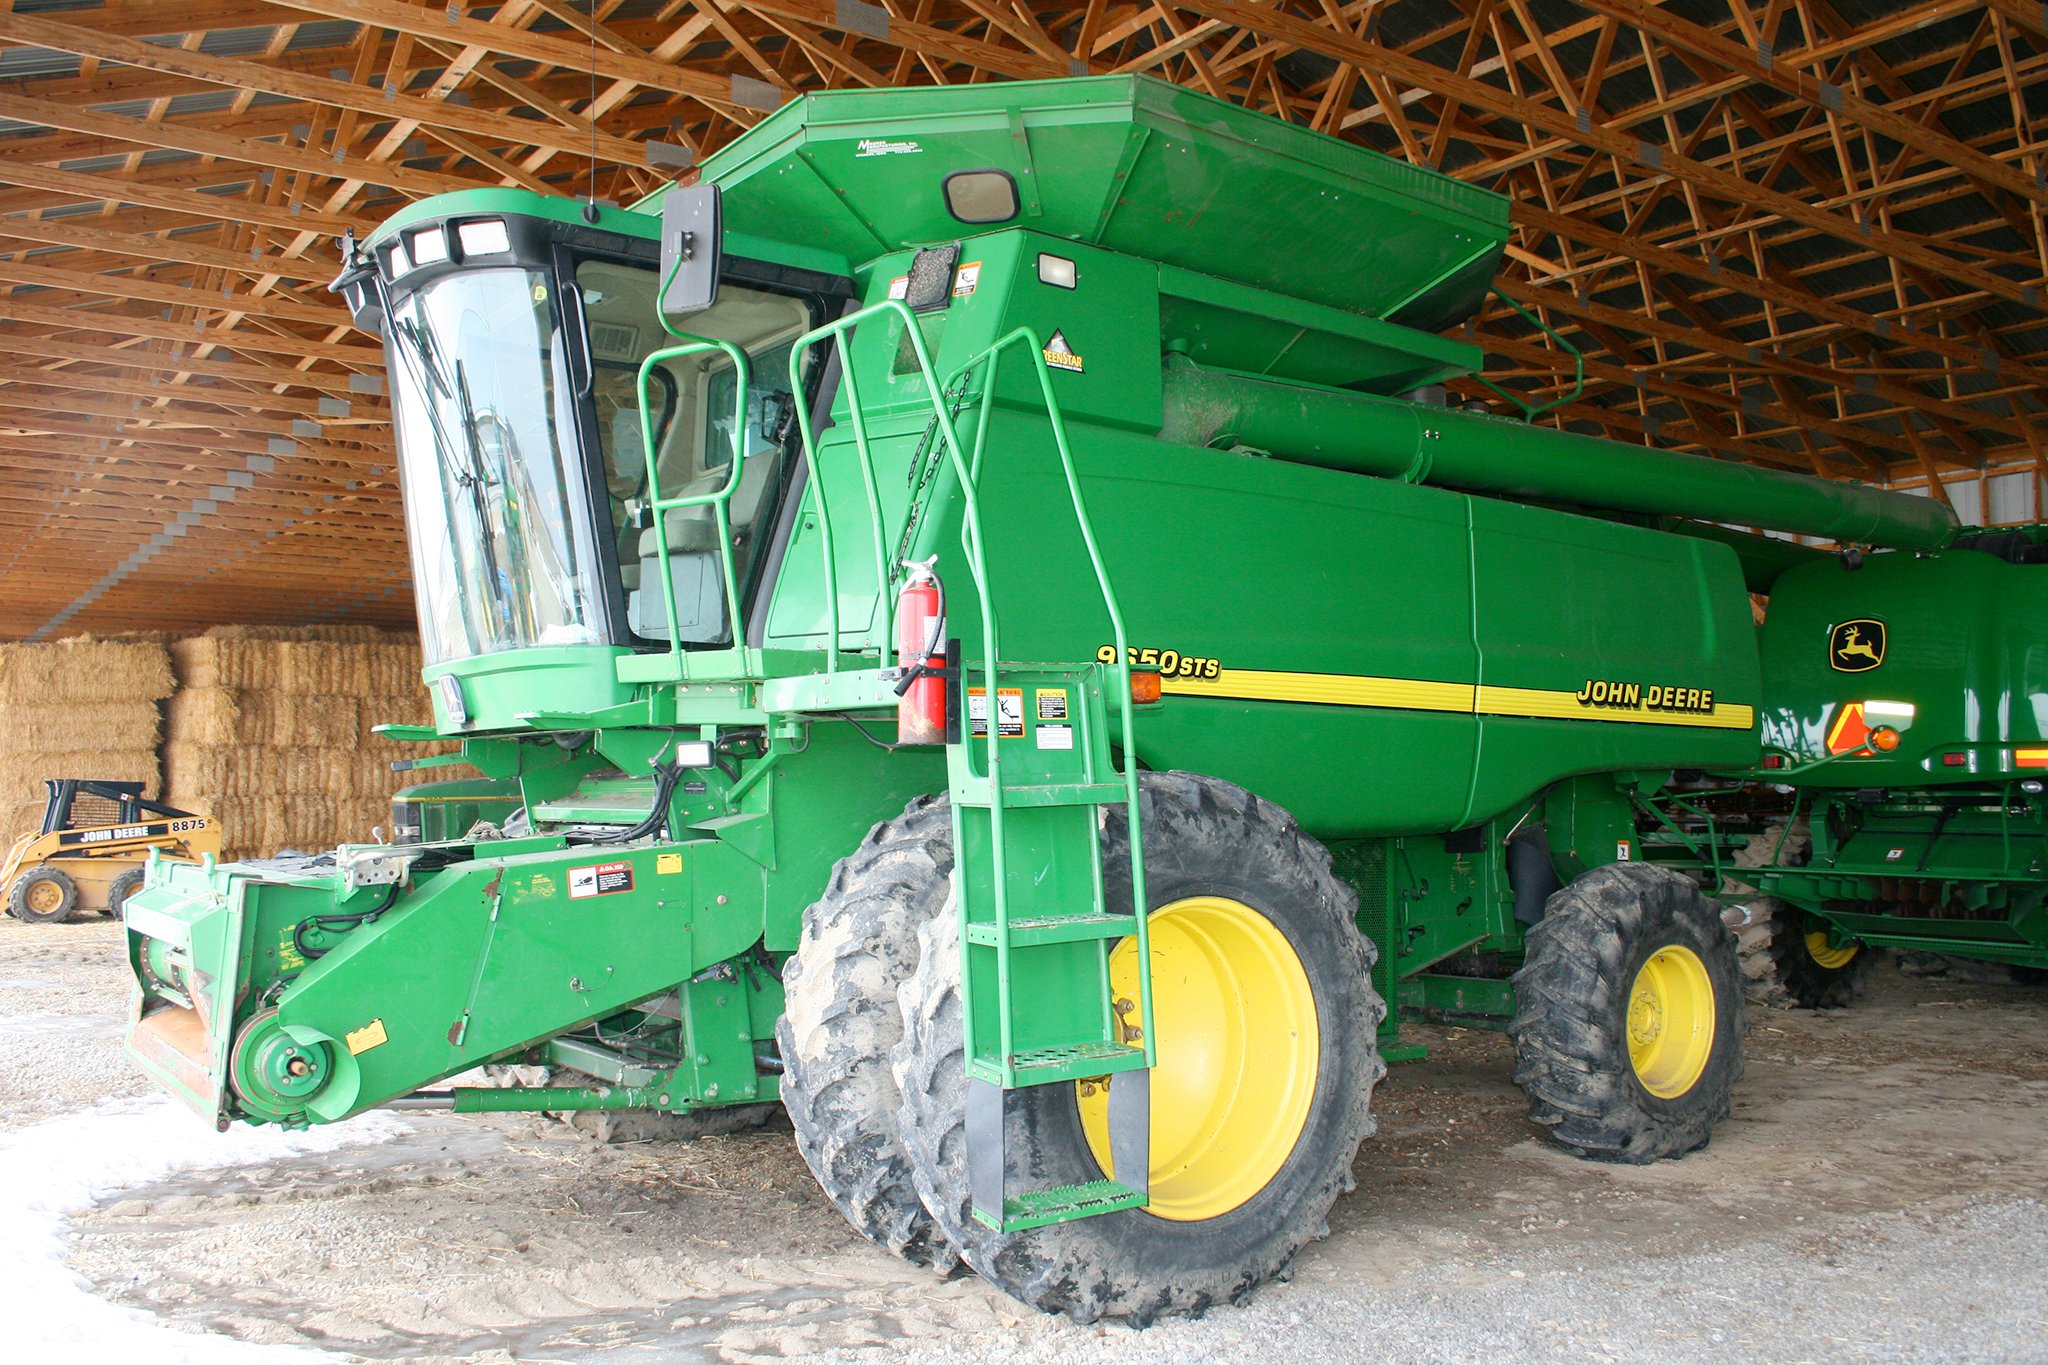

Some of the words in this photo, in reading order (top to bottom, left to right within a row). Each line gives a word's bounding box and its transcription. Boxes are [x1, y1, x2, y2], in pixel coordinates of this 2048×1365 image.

[1042, 349, 1083, 368] REENSTAR
[1577, 680, 1641, 706] JOHN
[1646, 684, 1713, 711] DEERE
[80, 829, 112, 843] JOHN
[114, 826, 149, 840] DEERE
[172, 818, 206, 832] 8875
